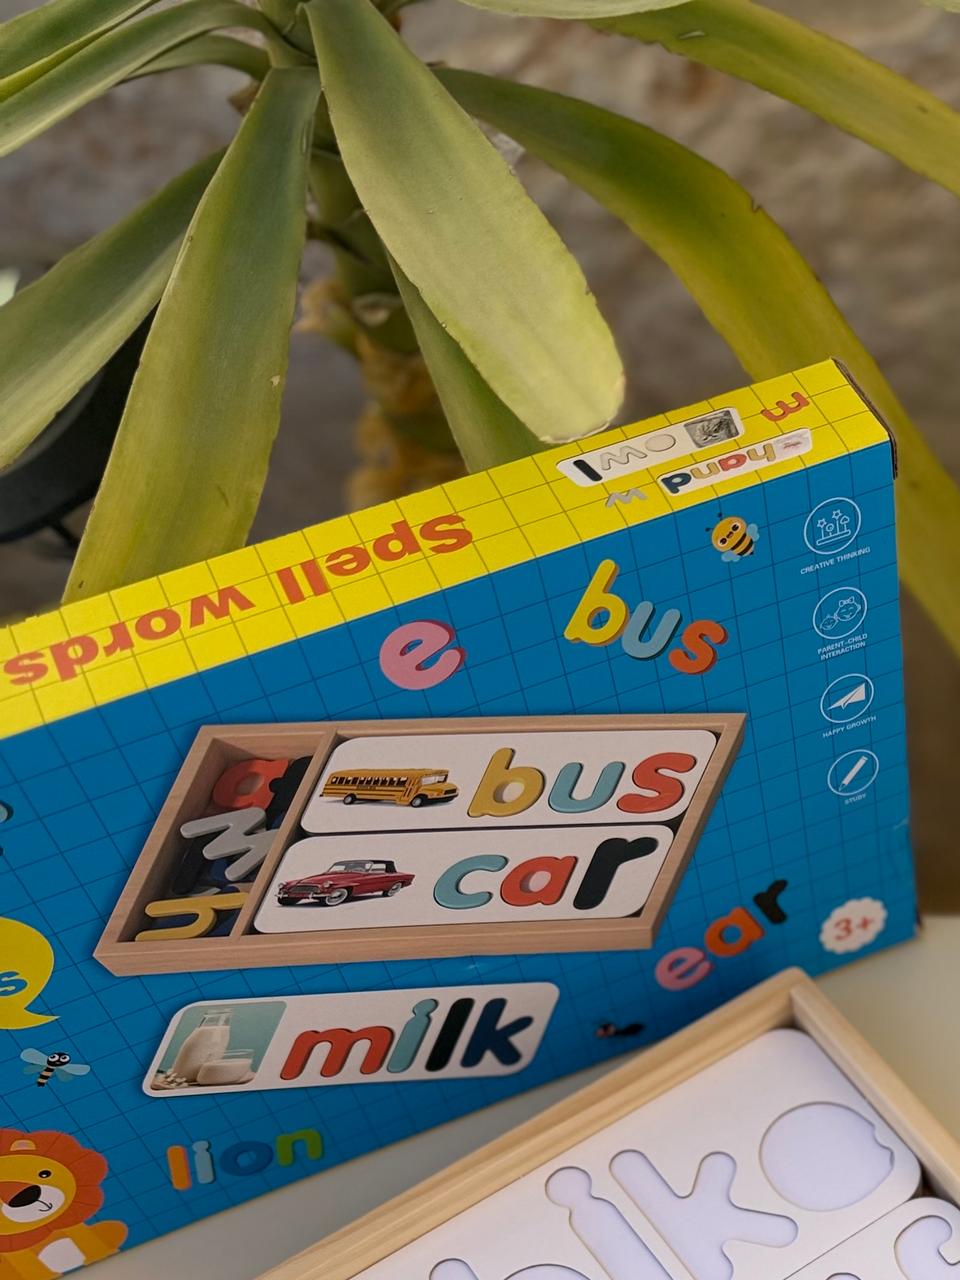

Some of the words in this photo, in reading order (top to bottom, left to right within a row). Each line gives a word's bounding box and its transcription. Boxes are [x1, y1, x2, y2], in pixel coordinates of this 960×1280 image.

[660, 442, 776, 495] hand
[275, 513, 474, 605] Spell
[800, 557, 835, 575] CREATIVE
[836, 546, 872, 563] THINKING
[2, 585, 257, 687] words
[563, 558, 729, 675] bus
[820, 641, 866, 661] INTERACTION
[379, 619, 467, 691] e
[822, 725, 846, 739] HAPPY
[846, 715, 877, 730] GROWTH
[467, 746, 698, 819] bus
[433, 836, 660, 911] car
[655, 878, 789, 991] ear
[833, 915, 875, 942] 3+
[279, 997, 535, 1081] milk
[166, 1126, 325, 1191] lion
